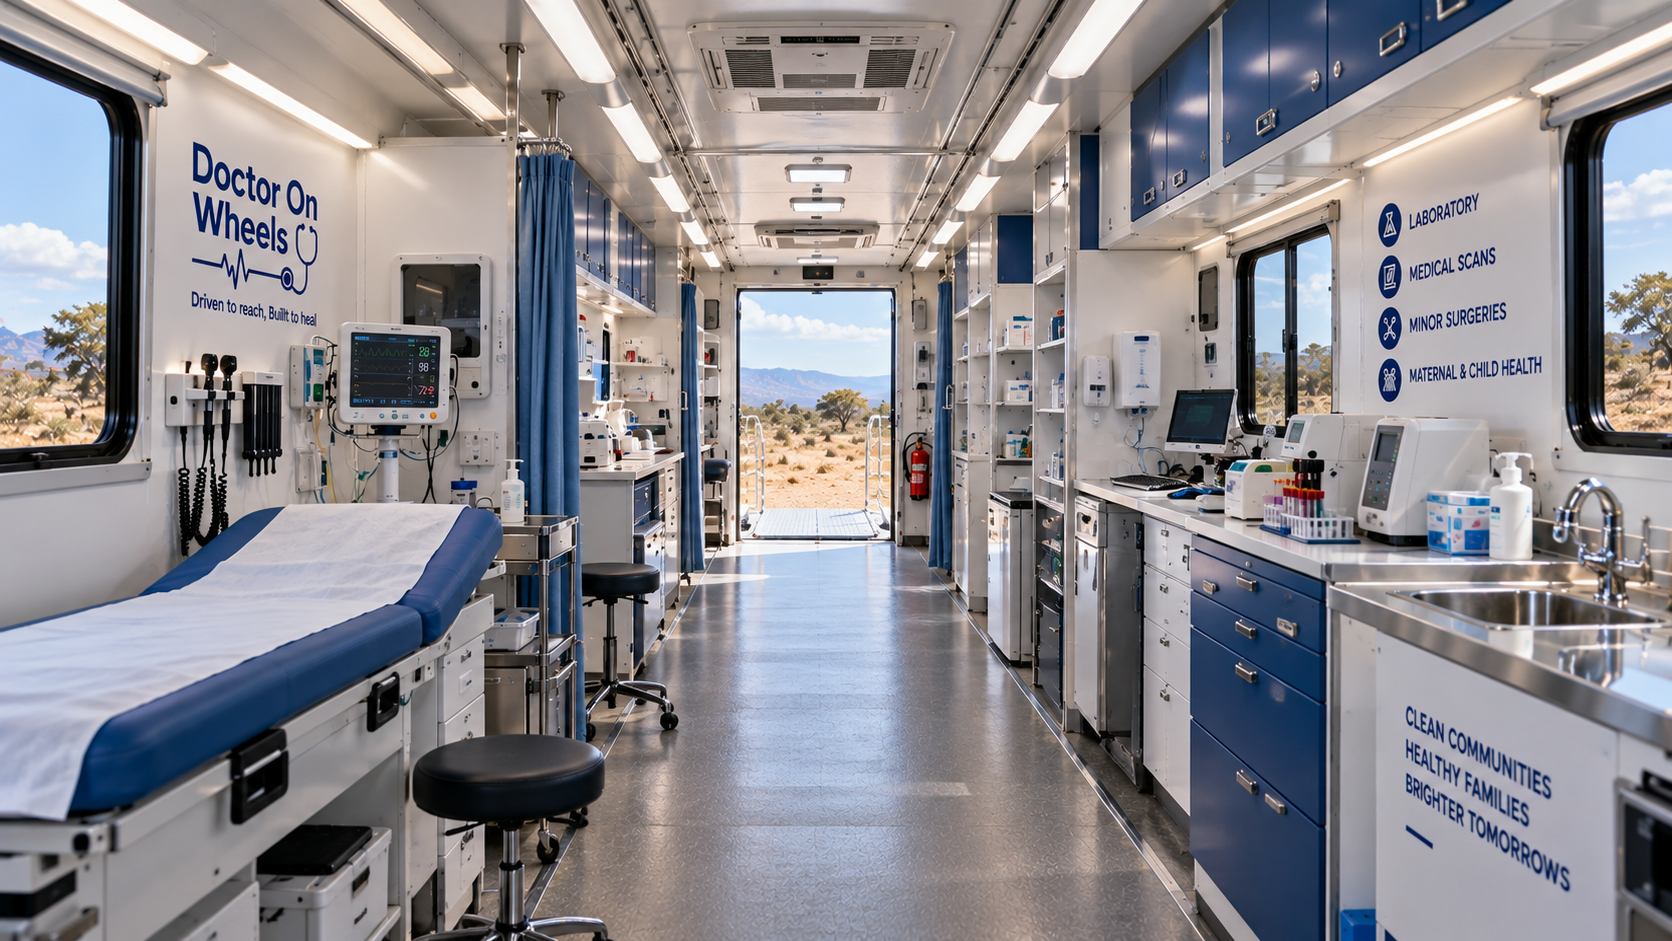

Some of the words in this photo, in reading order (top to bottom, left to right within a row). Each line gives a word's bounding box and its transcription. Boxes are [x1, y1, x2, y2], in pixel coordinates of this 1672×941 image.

[193, 142, 281, 208] Doctor
[287, 180, 317, 221] On
[193, 191, 288, 254] Wheels
[1409, 193, 1479, 230] LABORATORY
[1409, 257, 1455, 281] MEDICAL
[1458, 247, 1496, 271] SCANS
[192, 291, 224, 312] Driven
[227, 299, 237, 313] to
[240, 303, 267, 321] reach,
[291, 310, 299, 323] to
[301, 311, 317, 326] heal
[1409, 313, 1443, 333] MINOR
[1446, 302, 1507, 328] SURGERIES
[1409, 364, 1457, 382] MATERNAL
[1460, 363, 1467, 379] &
[1469, 361, 1499, 378] CHILD
[1502, 356, 1542, 376] HEALTH
[1406, 706, 1444, 743] CLEAN
[1448, 728, 1552, 799] COMMUNITIES
[1406, 739, 1461, 787] HEALTHY
[1465, 771, 1530, 827] FAMILIES
[1406, 773, 1464, 827] BRIGHTER
[1467, 809, 1571, 892] TOMORROWS
